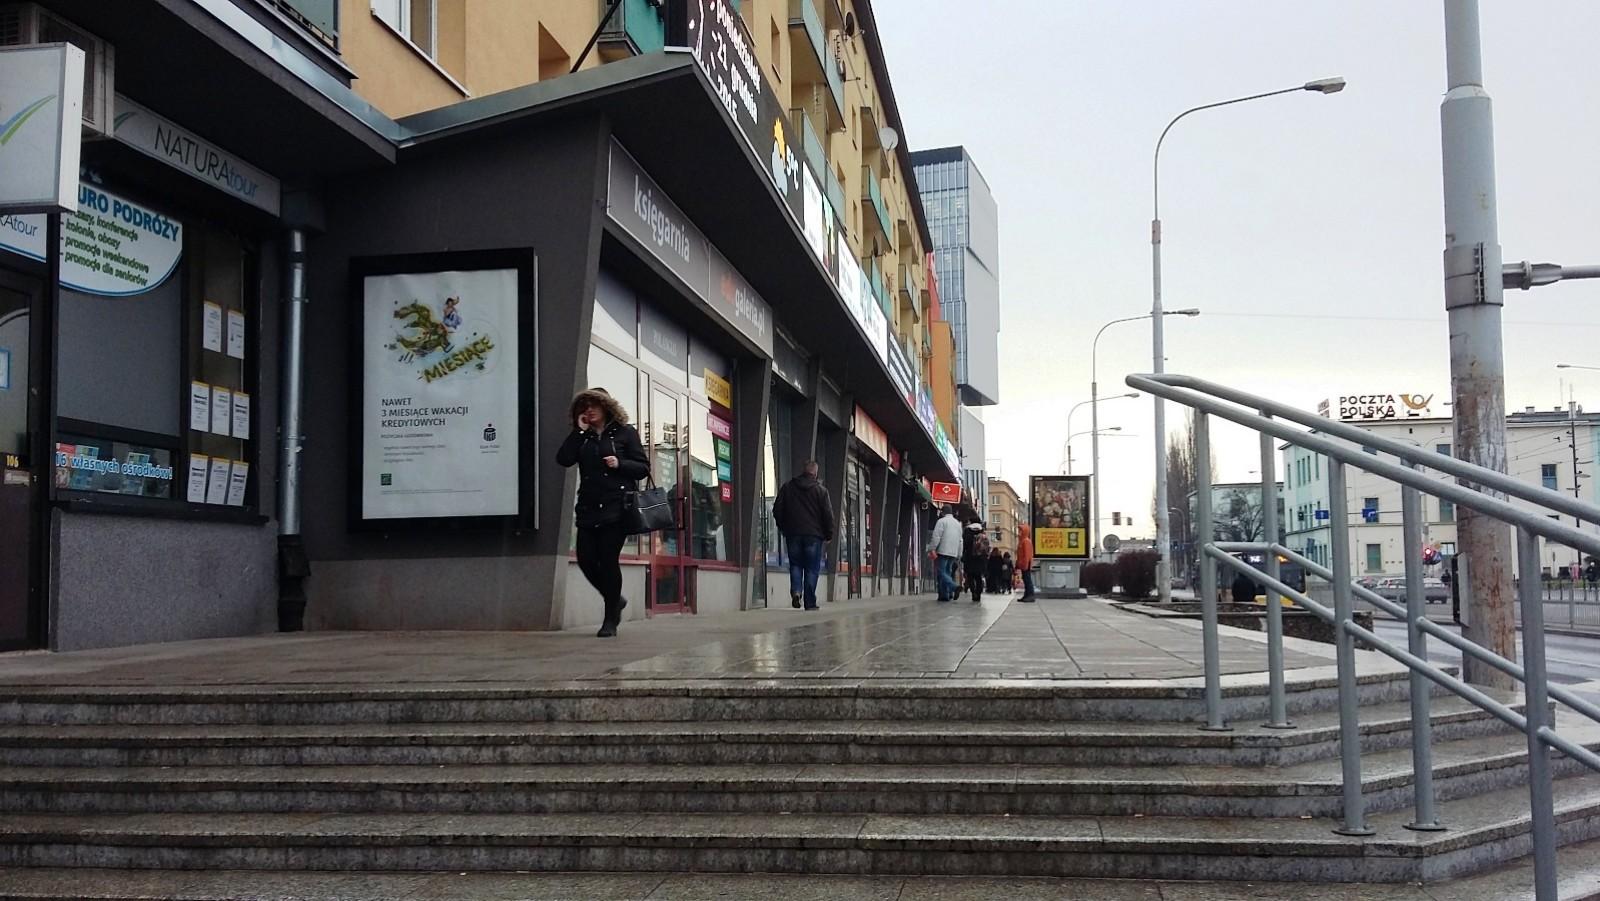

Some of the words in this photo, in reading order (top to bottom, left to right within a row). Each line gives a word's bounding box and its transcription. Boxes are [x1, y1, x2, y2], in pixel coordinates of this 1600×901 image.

[731, 62, 758, 124] grudnia
[155, 124, 258, 199] NATURAtour
[78, 186, 108, 213] URO
[113, 198, 179, 242] PODRÓŻY
[634, 174, 690, 263] księgarnia
[381, 398, 412, 406] NAWET
[1339, 394, 1395, 406] POCZTA
[381, 409, 387, 417] 3
[388, 407, 430, 418] MIESIĄCE
[431, 406, 469, 416] WAKACJI
[1339, 405, 1396, 417] POLSKA
[381, 418, 446, 428] KREDYTOWYCH
[55, 451, 67, 467] 16
[70, 454, 120, 475] własnych
